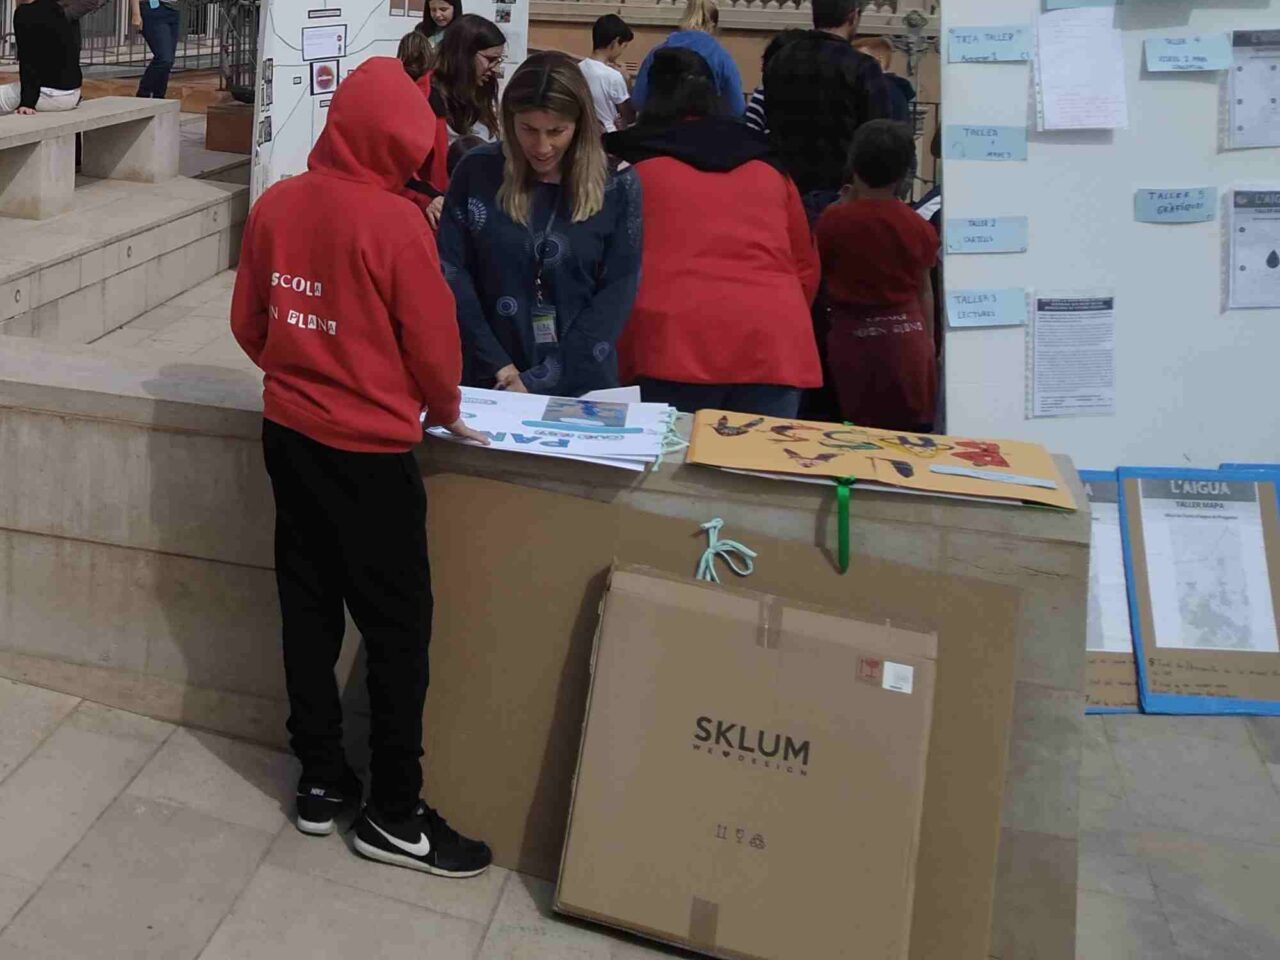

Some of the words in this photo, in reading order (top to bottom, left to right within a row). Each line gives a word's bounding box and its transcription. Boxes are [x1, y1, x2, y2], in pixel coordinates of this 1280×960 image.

[271, 272, 322, 297] SCOLA
[1170, 480, 1231, 495] L'AIGUA
[694, 716, 810, 766] SKLUM
